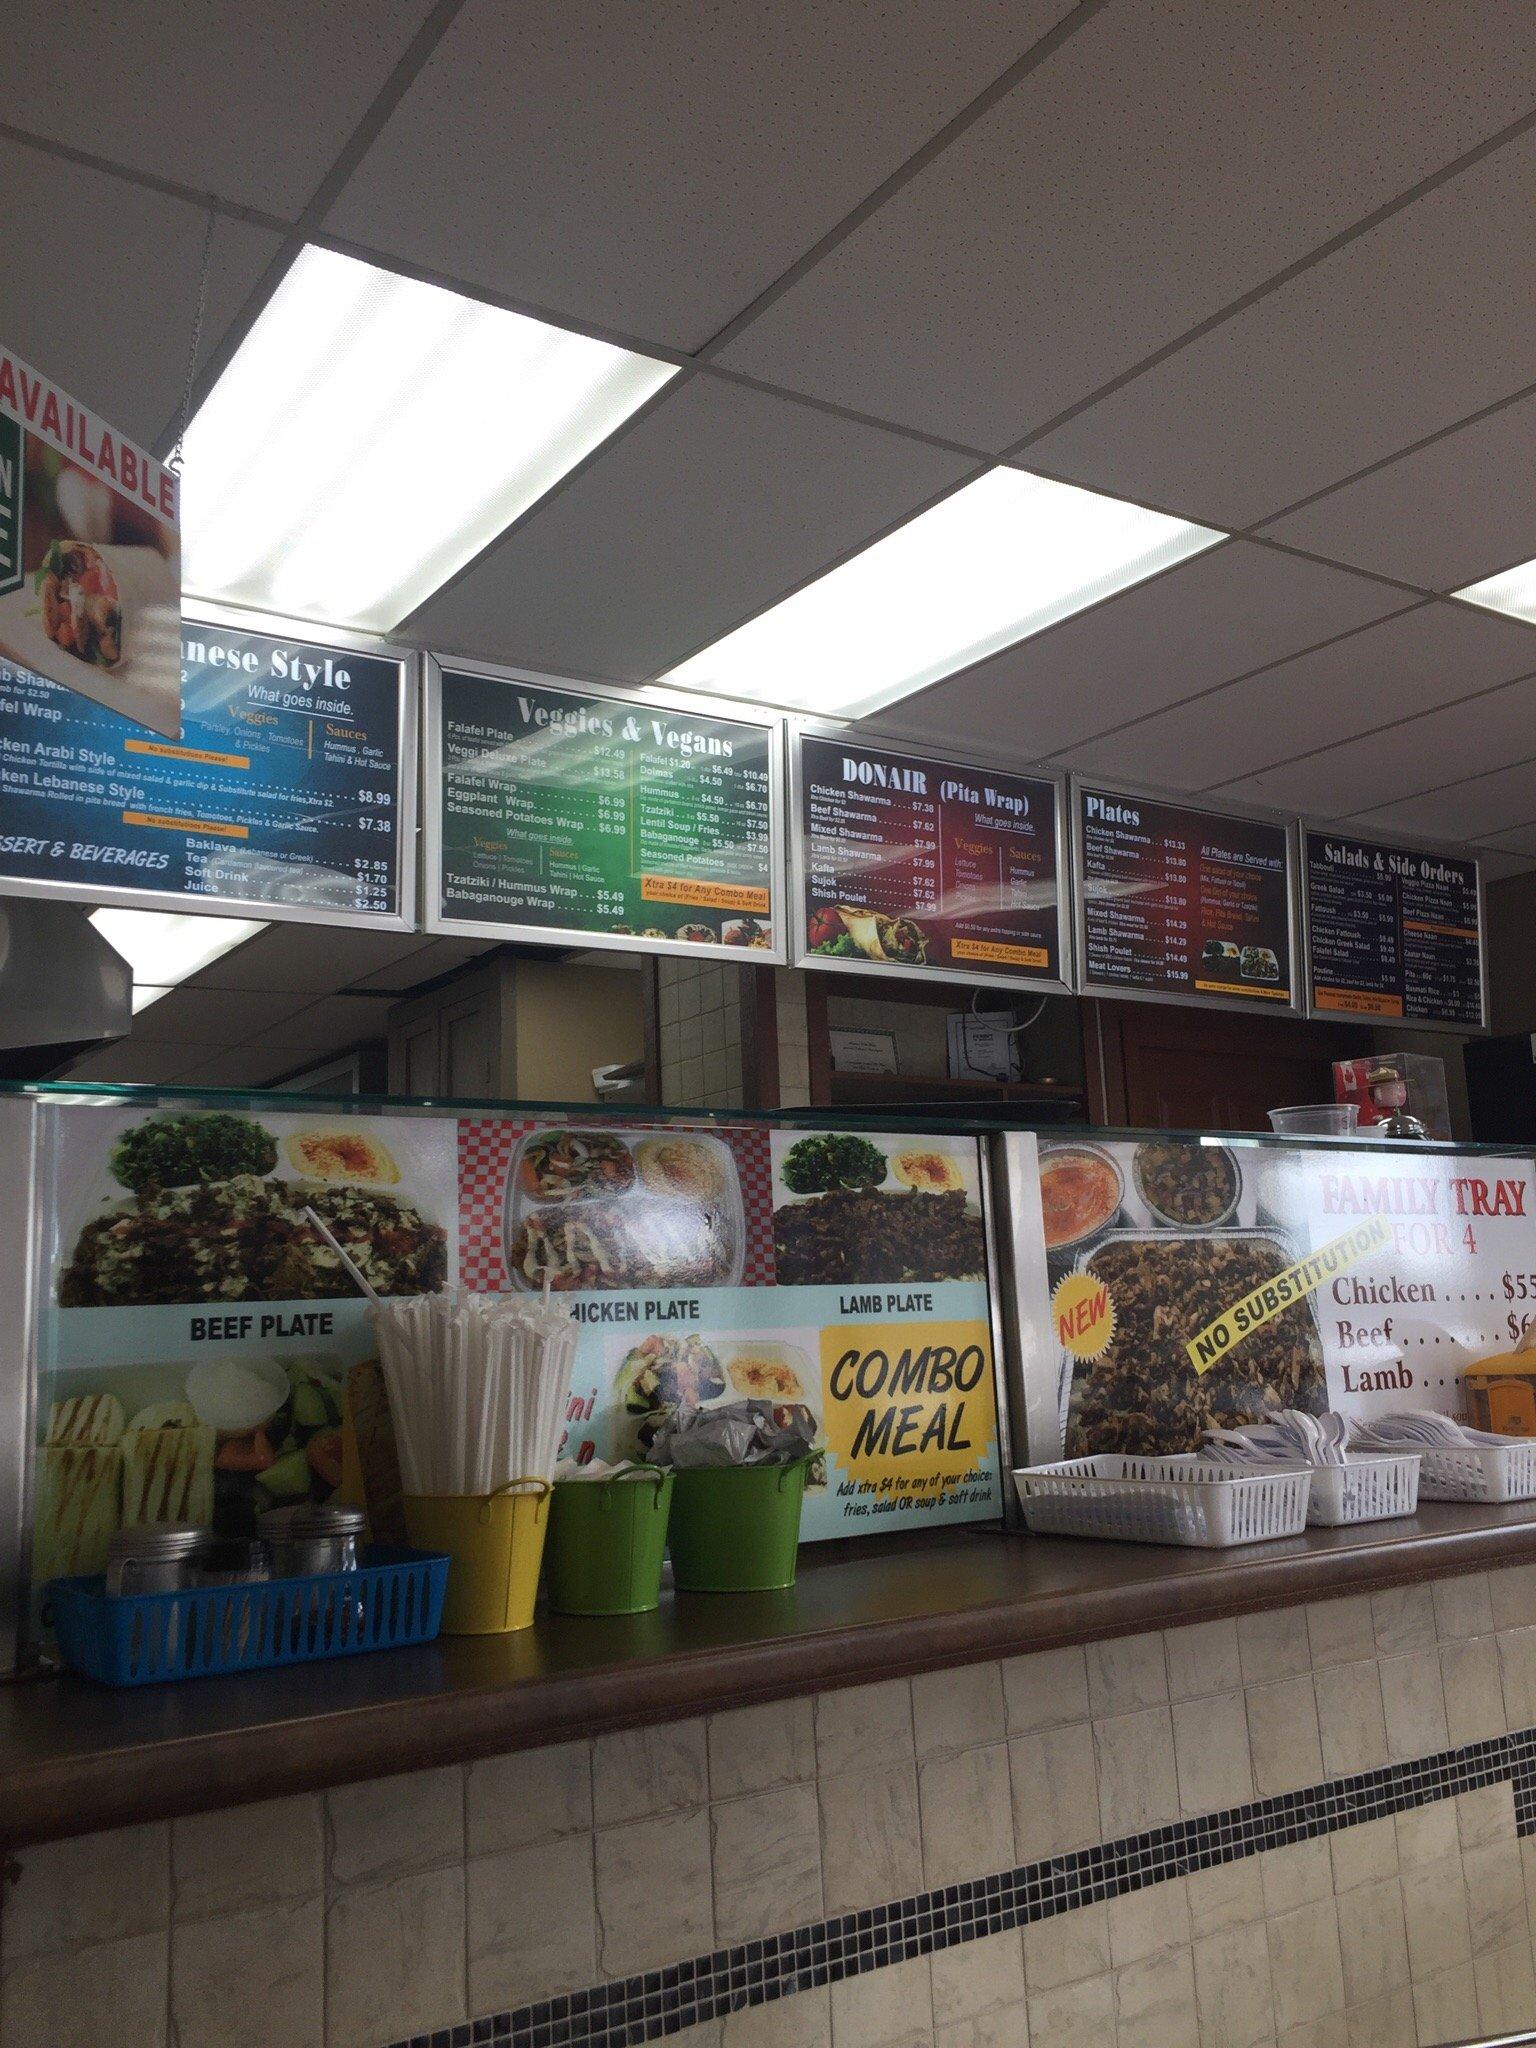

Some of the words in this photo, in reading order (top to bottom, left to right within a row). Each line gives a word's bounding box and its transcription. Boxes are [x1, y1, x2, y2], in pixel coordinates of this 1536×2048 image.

[0, 358, 174, 520] AVAILABLE
[271, 649, 351, 690] Style
[13, 686, 26, 695] for
[27, 688, 50, 699] $2.50
[248, 684, 279, 703] What
[282, 692, 313, 709] goes
[315, 696, 354, 716] inside.
[23, 701, 62, 722] Wrap
[229, 704, 279, 727] Veggies
[326, 723, 368, 741] Sauces
[447, 720, 484, 736] Falafel
[486, 727, 514, 741] Plate
[594, 746, 626, 760] $12.49
[517, 696, 613, 738] Veggies
[622, 716, 642, 743] &
[651, 720, 733, 758] Vegans
[324, 752, 345, 765] Tahini
[354, 757, 367, 768] Hot
[368, 759, 392, 771] Sauce
[362, 745, 384, 757] Garlic
[447, 742, 478, 757] Veggi
[481, 748, 518, 763] Deluxe
[520, 754, 547, 768] Plate
[594, 766, 625, 780] $13.58
[3, 753, 37, 766] Chicken
[39, 760, 67, 770] Tortilla
[68, 763, 87, 772] with
[88, 766, 105, 775] side
[106, 768, 116, 777] of
[117, 771, 142, 781] mixed
[143, 774, 164, 784] salad
[173, 777, 195, 788] garlic
[34, 742, 75, 760] Arabi
[79, 748, 116, 767] Style
[358, 789, 391, 806] $8.99
[447, 772, 486, 788] Falafel
[488, 778, 517, 794] Wrap
[598, 795, 626, 808] $6.99
[810, 784, 845, 798] Chicken
[847, 790, 892, 806] Shawarma
[912, 801, 934, 813] $7.38
[842, 757, 928, 795] DONAIR
[940, 780, 979, 803] (Pita
[984, 787, 1030, 817] Wrap)
[33, 772, 105, 794] Lebanese
[109, 782, 146, 801] Style
[358, 817, 391, 833] $7.38
[447, 787, 498, 805] Eggplant
[598, 808, 626, 822] $6.99
[810, 803, 831, 815] Beef
[832, 807, 877, 822] Shawarma
[913, 820, 935, 831] $7.62
[1086, 795, 1140, 827] Plates
[447, 802, 503, 819] Seasoned
[505, 811, 554, 827] Potatoes
[556, 817, 584, 832] Wrap
[598, 822, 626, 836] $6.99
[640, 817, 666, 829] Lentil
[668, 821, 691, 834] Soup
[698, 825, 720, 836] Fries
[746, 831, 769, 842] $3.99
[810, 823, 837, 835] Mixed
[838, 827, 883, 842] Shawarma
[640, 829, 699, 845] Babaganouge
[712, 839, 734, 850] $5.50
[747, 843, 768, 854] $7.50
[1086, 825, 1114, 838] Chicken
[1116, 830, 1151, 844] Shawarma
[50, 841, 65, 858] &
[70, 842, 170, 870] BEVERAGES
[186, 837, 237, 853] Baklava
[354, 858, 388, 872] $2.85
[640, 848, 685, 862] Seasoned
[687, 855, 725, 868] Potatoes
[758, 862, 768, 872] $4
[811, 843, 836, 854] Lamb
[837, 847, 882, 861] Shawarma
[1325, 842, 1369, 868] Salads
[1374, 851, 1384, 872] &
[1389, 855, 1416, 877] Side
[1421, 860, 1464, 885] Orders
[185, 851, 208, 864] Tea
[357, 871, 387, 884] $1.70
[185, 865, 212, 879] Soft
[215, 869, 249, 883] Drink
[355, 885, 387, 898] $1.25
[811, 862, 835, 874] Kafta
[913, 876, 935, 887] $7.62
[812, 875, 837, 888] Sujok
[184, 880, 219, 893] Juice
[354, 898, 387, 911] $2.50
[446, 872, 490, 888] Tzatziki
[498, 878, 547, 894] Hummus
[549, 884, 578, 899] Wrap
[597, 889, 624, 901] $5.49
[446, 888, 524, 907] Babaganouge
[527, 896, 555, 910] Wrap
[596, 903, 624, 915] $5.49
[644, 878, 664, 889] Xtra
[667, 881, 677, 890] $4
[680, 883, 692, 892] for
[694, 885, 711, 896] Any
[714, 887, 744, 898] Combo
[746, 891, 766, 901] Meal
[812, 888, 837, 900] Shish
[839, 890, 867, 903] Poulet
[1087, 907, 1108, 917] Mixed
[1109, 910, 1145, 923] Shawarma
[1319, 1174, 1439, 1216] FAMILY
[1450, 1177, 1527, 1217] TRAY
[1390, 1221, 1454, 1256] FOR
[1463, 1222, 1478, 1255] 4
[840, 1295, 883, 1315] LAMB
[887, 1293, 933, 1313] PLATE
[1196, 1324, 1230, 1365] NO
[1233, 1220, 1386, 1331] SUBSTITUTION
[1332, 1276, 1437, 1305] Chicken
[570, 1302, 639, 1323] HICKEN
[645, 1299, 700, 1321] PLATE
[1058, 1284, 1110, 1347] NEW
[190, 1316, 253, 1342] BEEF
[260, 1312, 334, 1338] PLATE
[1336, 1318, 1394, 1349] Beef
[829, 1344, 986, 1402] COMBO
[1341, 1361, 1414, 1393] Lamb
[850, 1402, 972, 1460] MEAL
[836, 1480, 857, 1497] Add
[858, 1478, 878, 1495] xtra
[879, 1477, 893, 1493] $4
[895, 1475, 910, 1491] for
[911, 1478, 928, 1493] any
[929, 1472, 941, 1487] of
[941, 1473, 961, 1490] your
[963, 1468, 993, 1483] choice:
[843, 1502, 870, 1517] fries,
[872, 1499, 897, 1514] salad
[899, 1496, 913, 1511] OR
[914, 1495, 936, 1511] soup
[938, 1494, 946, 1506] &
[949, 1489, 969, 1505] soft
[969, 1487, 992, 1502] drink
